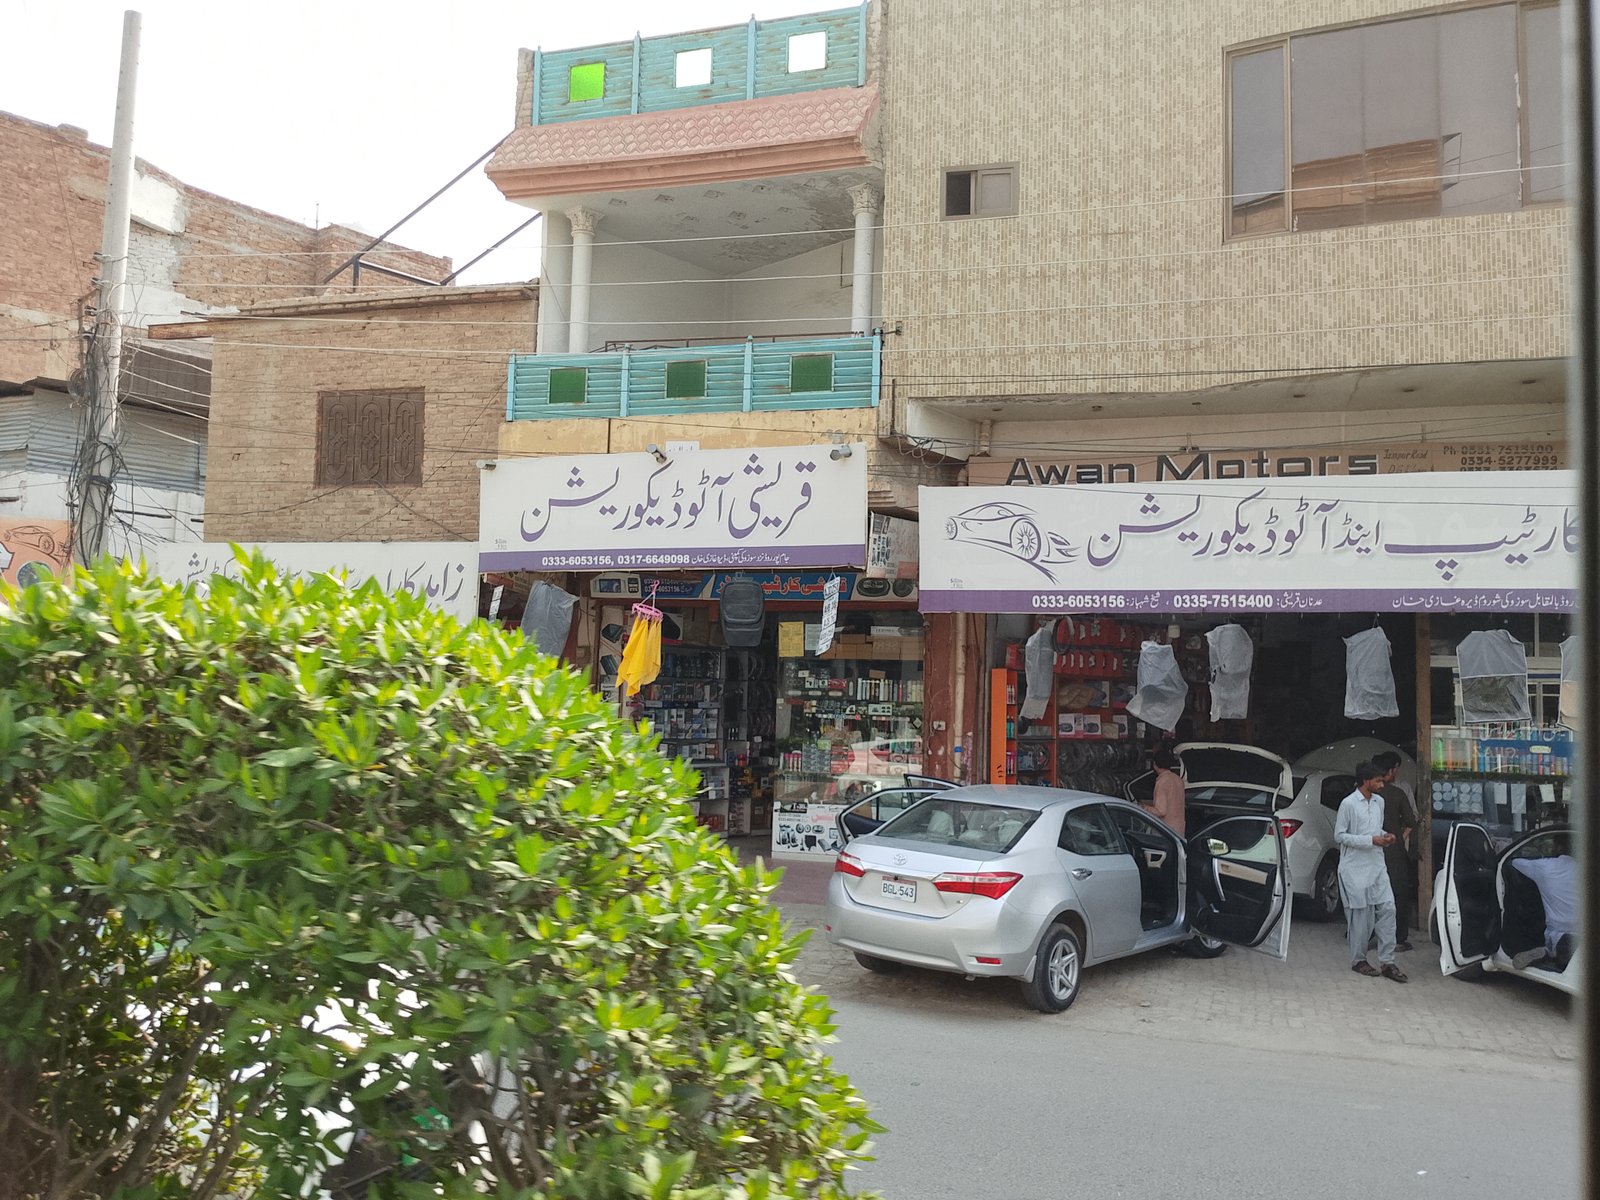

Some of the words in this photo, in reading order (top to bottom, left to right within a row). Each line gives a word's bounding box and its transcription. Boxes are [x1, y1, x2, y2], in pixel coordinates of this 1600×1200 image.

[1004, 457, 1137, 486] Awan
[1156, 450, 1379, 482] Motors
[520, 459, 685, 542] ڈیکوریشن
[682, 468, 735, 530] آٹو
[727, 453, 817, 540] قریشی
[1087, 487, 1280, 567] ڈیکوریشن
[1278, 495, 1341, 556] آٹو
[1332, 511, 1381, 554] اینڈ
[1384, 504, 1537, 581] ٹیپ
[617, 554, 690, 565] 0317-6649098
[1031, 594, 1125, 608] 0333-6053156
[1173, 594, 1273, 608] 0335-7515400
[1392, 594, 1425, 608] خان
[882, 883, 914, 898] BGL-543
